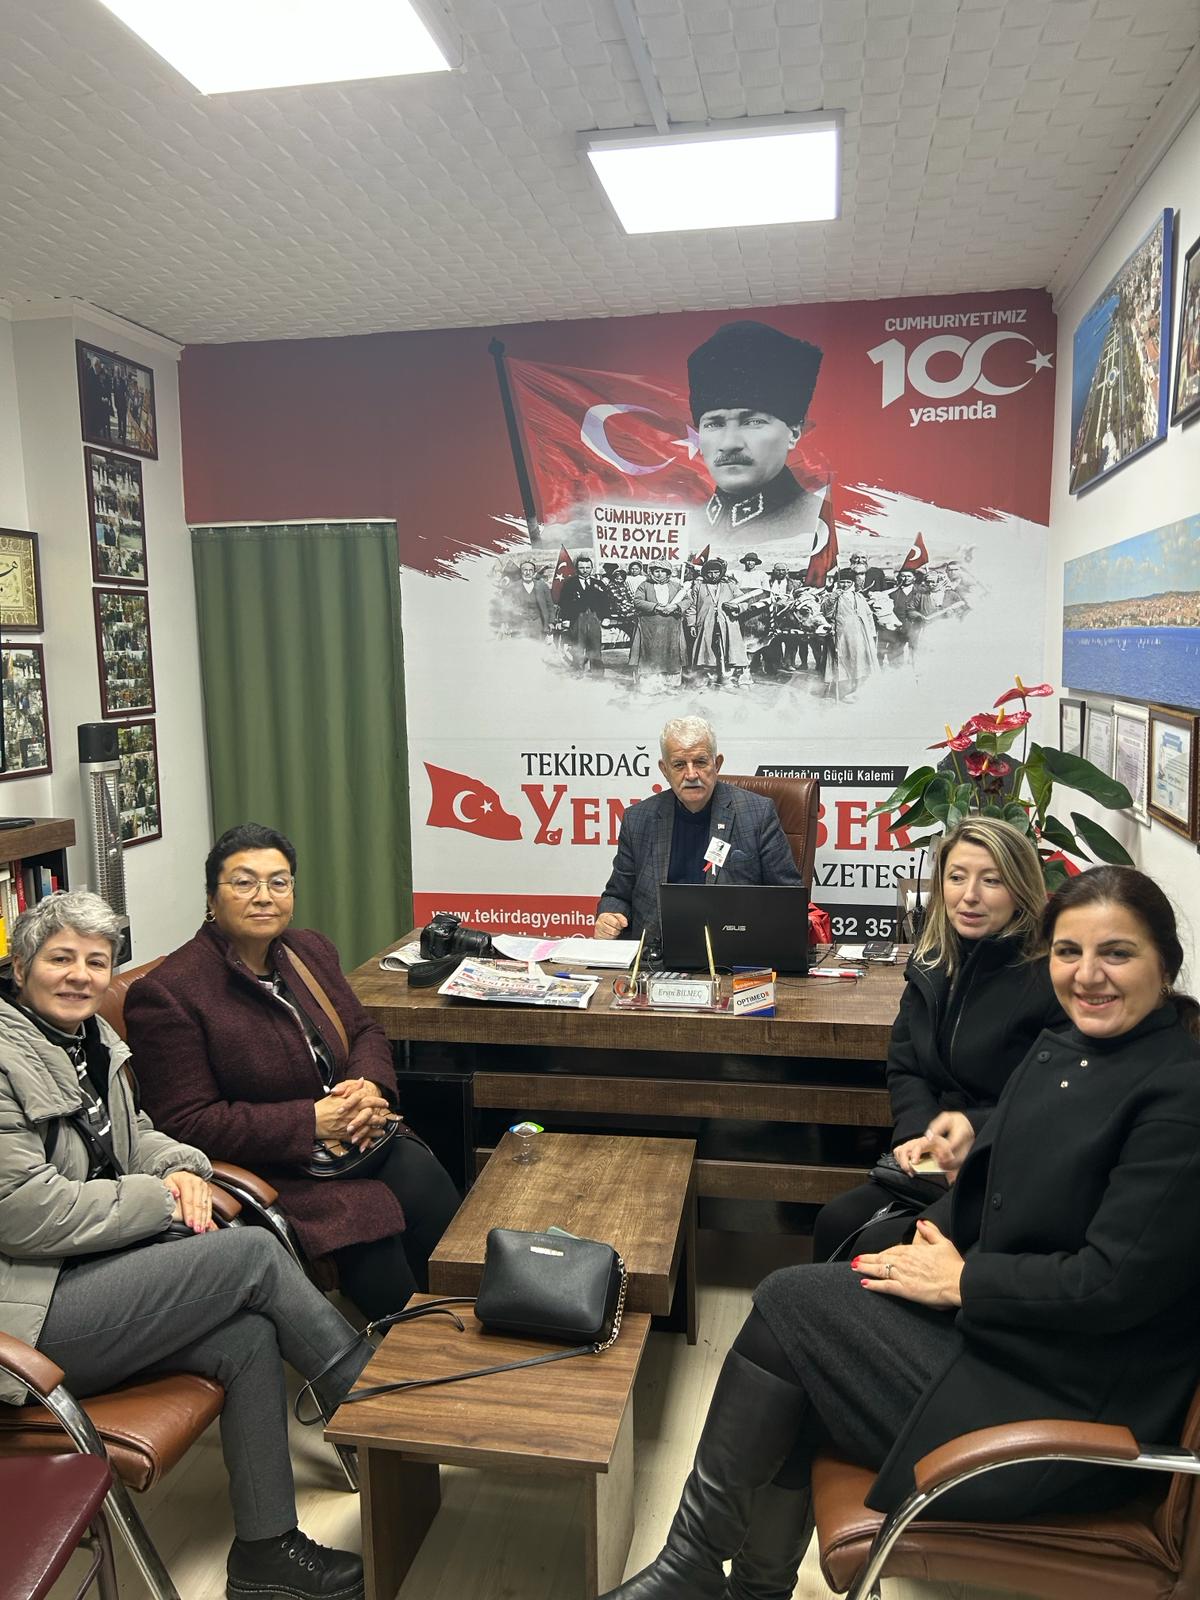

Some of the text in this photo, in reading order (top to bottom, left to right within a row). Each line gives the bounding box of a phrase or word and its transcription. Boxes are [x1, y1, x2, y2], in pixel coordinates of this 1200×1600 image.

[885, 309, 1027, 331] CUMHURİYETİMİZ
[909, 400, 997, 427] yaşında
[596, 525, 679, 544] BİZ BÖYLE
[599, 543, 680, 560] KAZANDIK
[520, 744, 651, 777] TEKİRDAĞ
[823, 769, 854, 784] Güçlü
[857, 770, 894, 781] Kalemi
[520, 783, 663, 846] YEN
[431, 908, 595, 929] ww.tekirdagyeniha
[831, 917, 898, 938] 32 35
